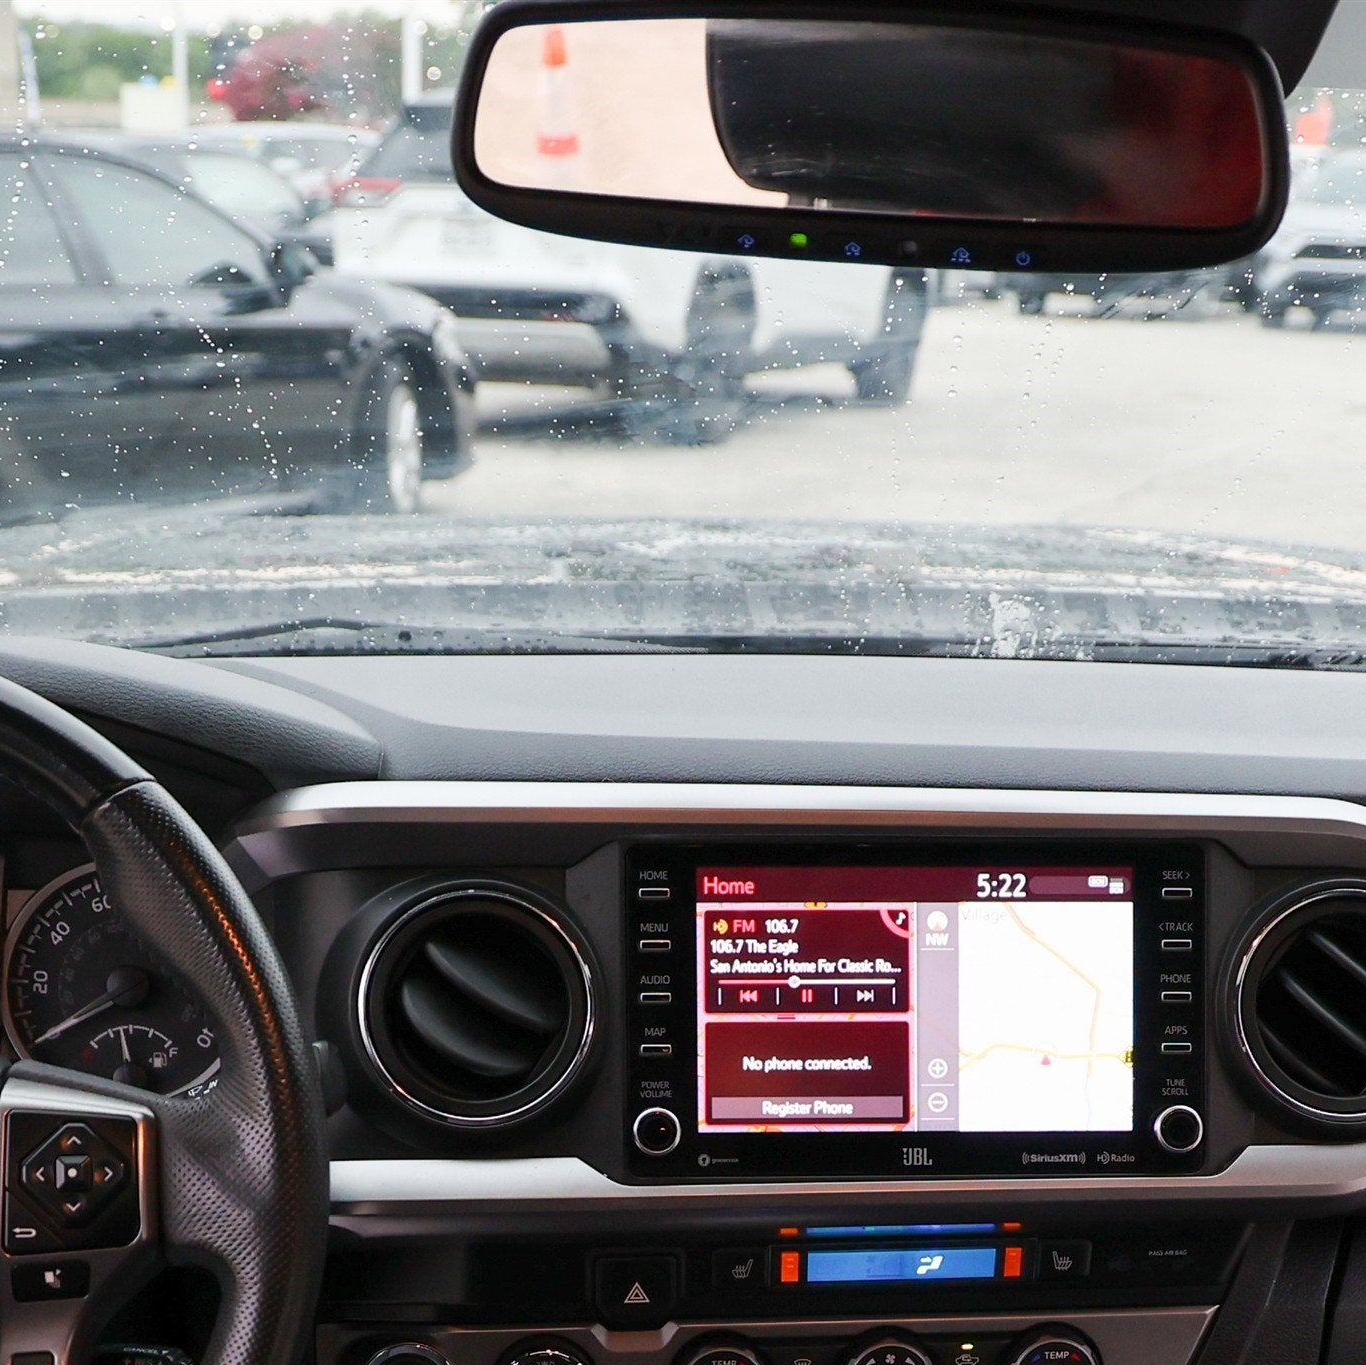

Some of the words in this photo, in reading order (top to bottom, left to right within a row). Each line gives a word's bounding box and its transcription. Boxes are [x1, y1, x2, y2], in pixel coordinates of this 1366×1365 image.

[640, 870, 668, 880] HOME
[703, 876, 755, 895] Home
[976, 873, 1027, 898] 5:22
[640, 923, 668, 932] MENU
[733, 920, 755, 933] FM
[765, 919, 799, 934] 106.7
[50, 921, 70, 945] 40
[925, 933, 949, 947] NW
[710, 939, 743, 954] 106.7
[747, 939, 765, 953] The
[766, 939, 799, 956] Eagle
[710, 959, 732, 974] San
[732, 958, 782, 974] Antonio's
[784, 959, 817, 973] Home
[818, 959, 836, 973] For
[837, 958, 874, 973] Classic
[33, 970, 48, 994] 20
[640, 975, 671, 985] AUDIO
[1160, 974, 1191, 983] PHONE
[645, 1027, 666, 1036] MAP
[1165, 1026, 1188, 1035] APPS
[168, 1046, 179, 1057] F
[743, 1056, 762, 1071] No
[765, 1056, 803, 1073] phone
[804, 1056, 872, 1071] connected.
[641, 1080, 670, 1089] POWER
[1166, 1078, 1185, 1087] TUNE
[640, 1090, 672, 1098] VOLUME
[1162, 1088, 1188, 1096] SCROLL
[762, 1101, 812, 1117] Register
[814, 1101, 853, 1115] Phone
[902, 1147, 932, 1166] JBL
[1111, 1153, 1135, 1162] Radio
[1044, 1351, 1070, 1360] TEMP
